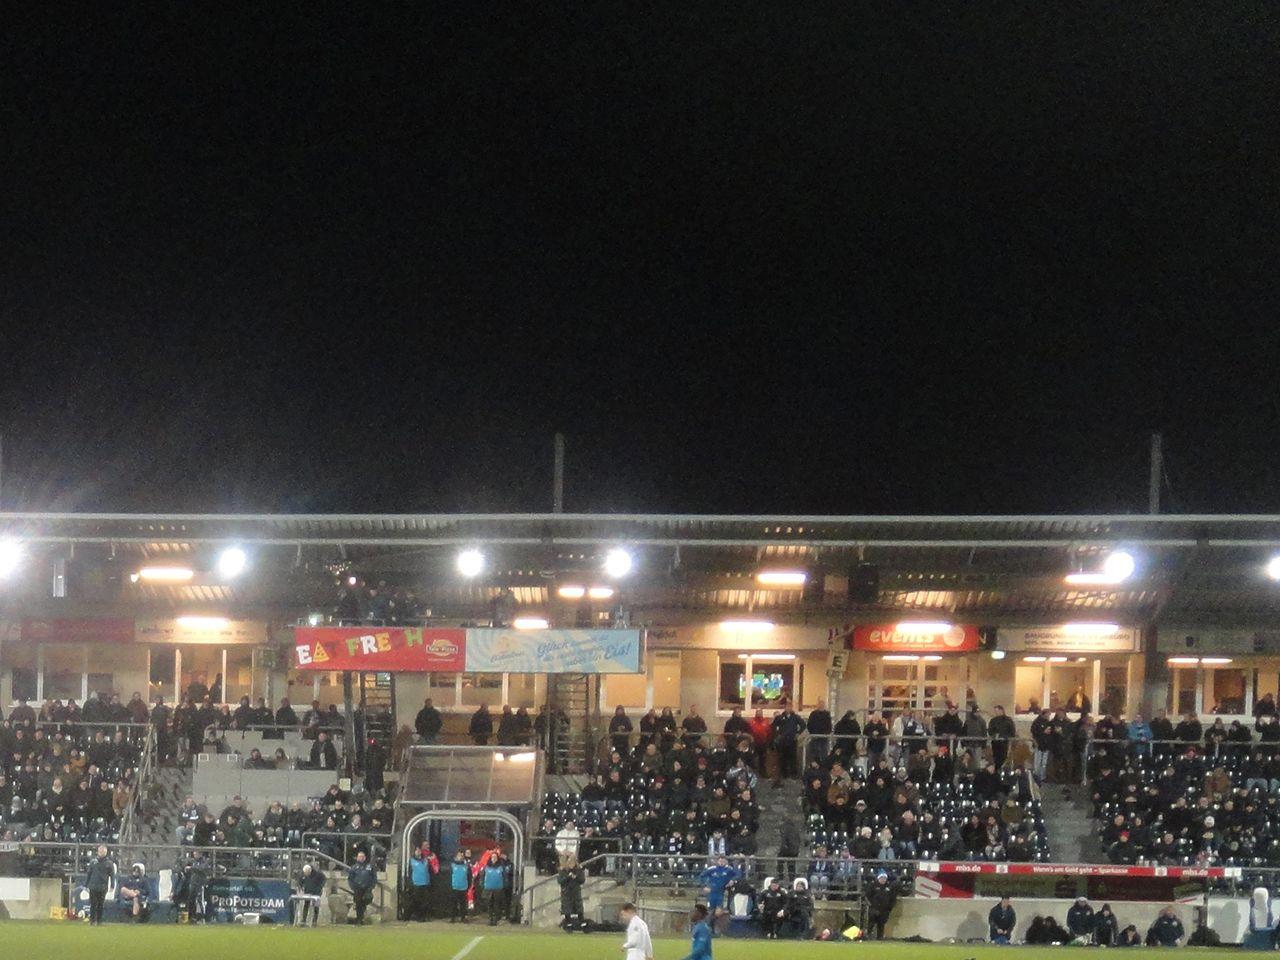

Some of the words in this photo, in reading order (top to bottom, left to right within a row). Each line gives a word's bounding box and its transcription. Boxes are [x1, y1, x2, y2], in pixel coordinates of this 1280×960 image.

[955, 864, 981, 873] mbs.de
[1098, 866, 1128, 875] Sparkasse
[1182, 868, 1208, 876] mbs.de
